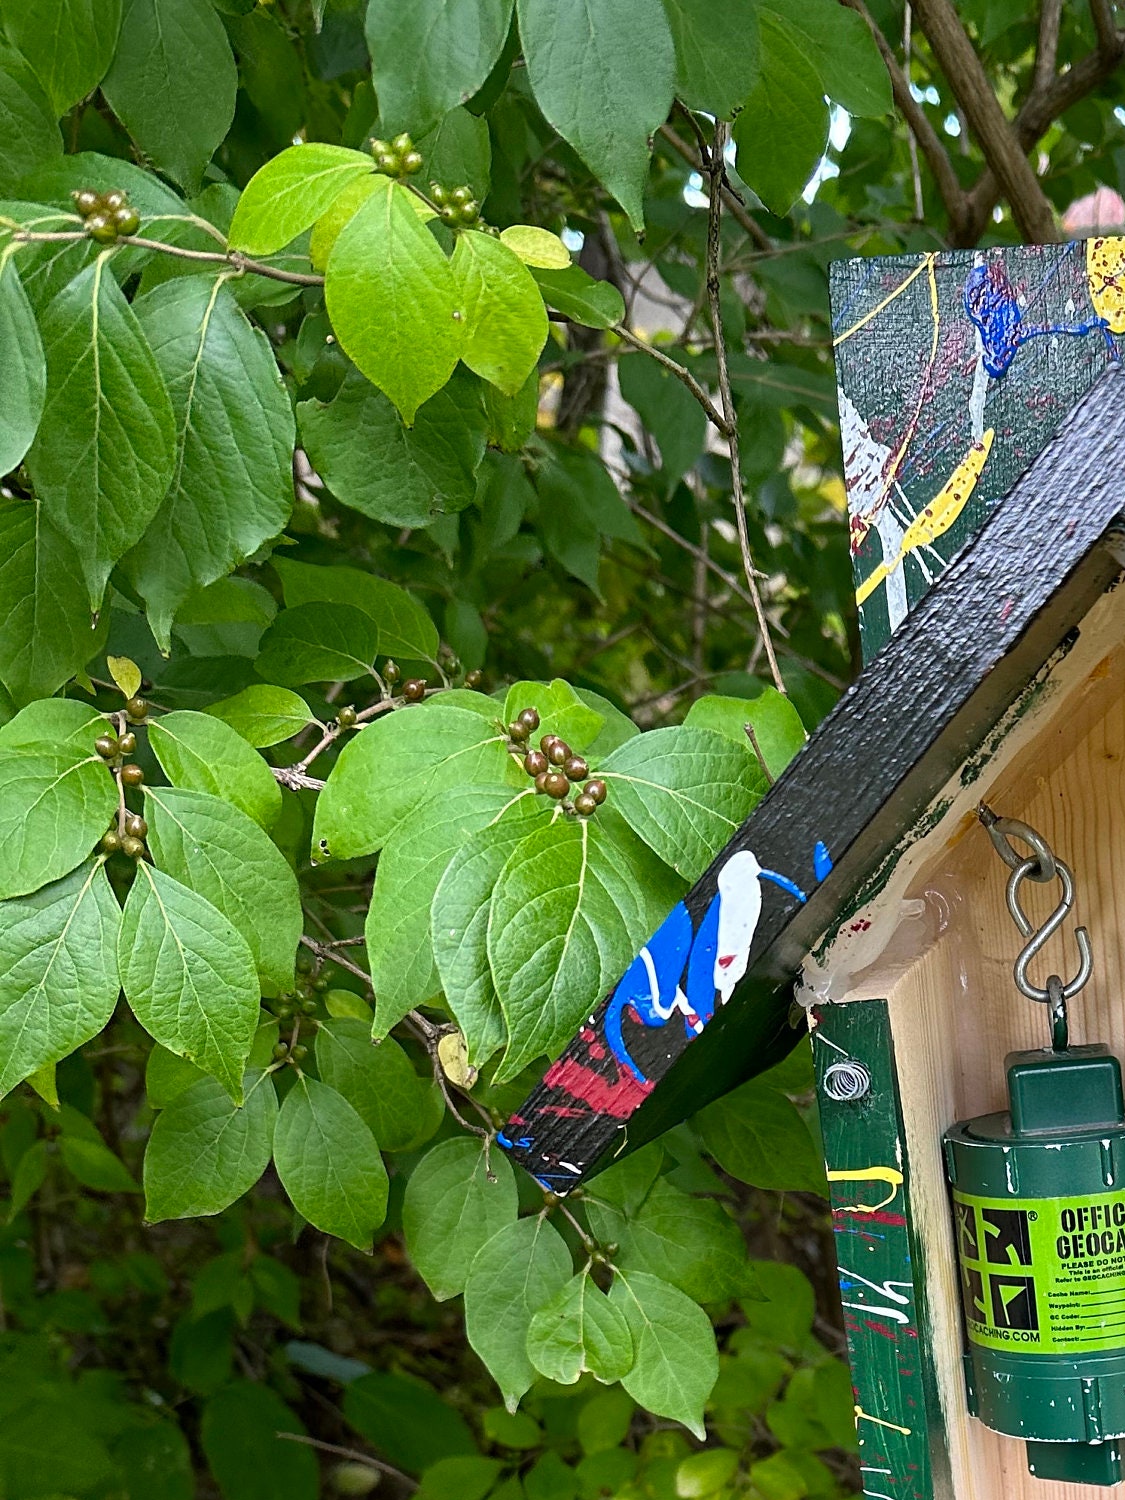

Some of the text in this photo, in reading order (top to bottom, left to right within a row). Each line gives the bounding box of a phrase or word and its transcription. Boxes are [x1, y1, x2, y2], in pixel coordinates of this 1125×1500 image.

[1061, 1261, 1094, 1270] PLEASE
[1096, 1259, 1109, 1267] DO
[1102, 1264, 1124, 1272] official
